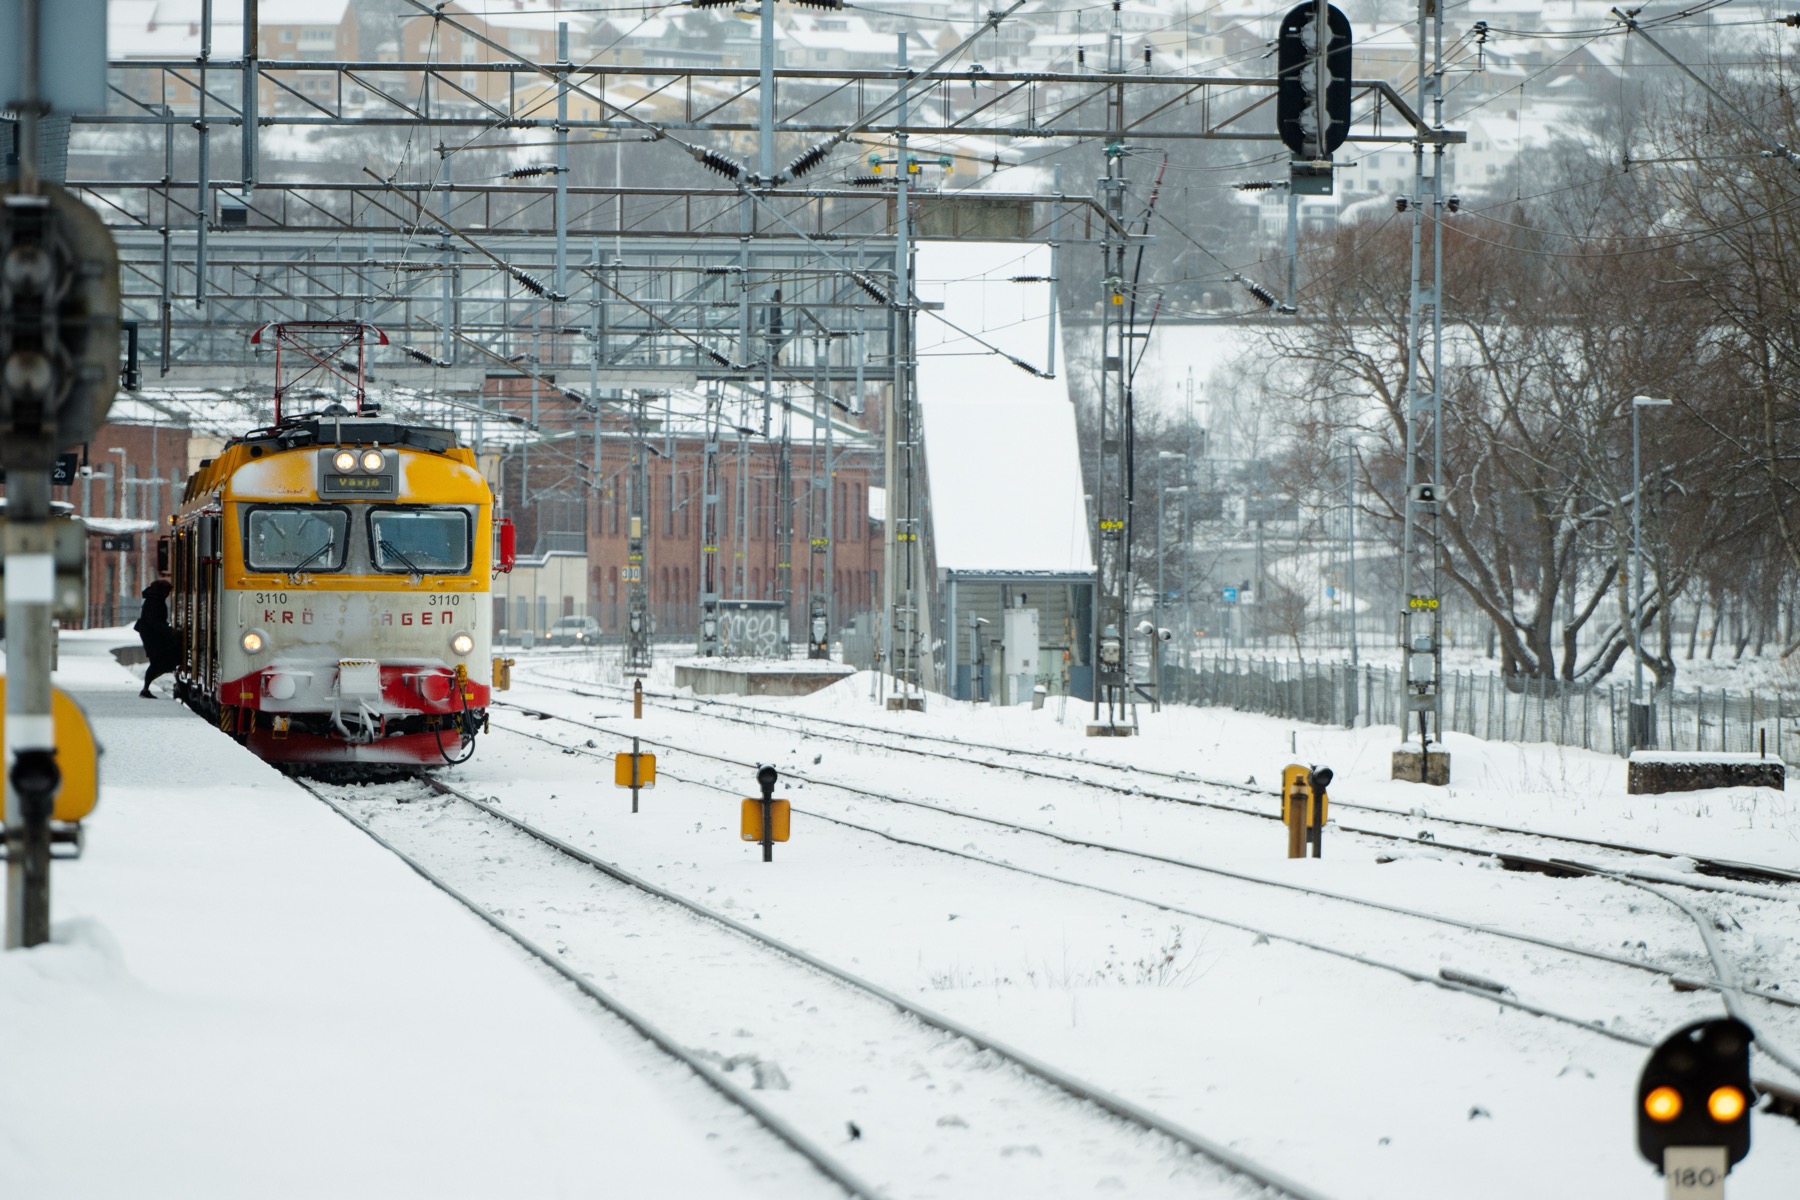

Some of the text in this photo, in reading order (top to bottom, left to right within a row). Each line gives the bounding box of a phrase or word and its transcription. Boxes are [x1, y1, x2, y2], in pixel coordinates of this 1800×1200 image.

[339, 477, 380, 488] Växjö
[1101, 521, 1123, 530] 69-9
[256, 592, 288, 605] 3110
[428, 594, 460, 606] 3110
[1410, 599, 1438, 608] 69-10
[1674, 1167, 1715, 1188] 180
